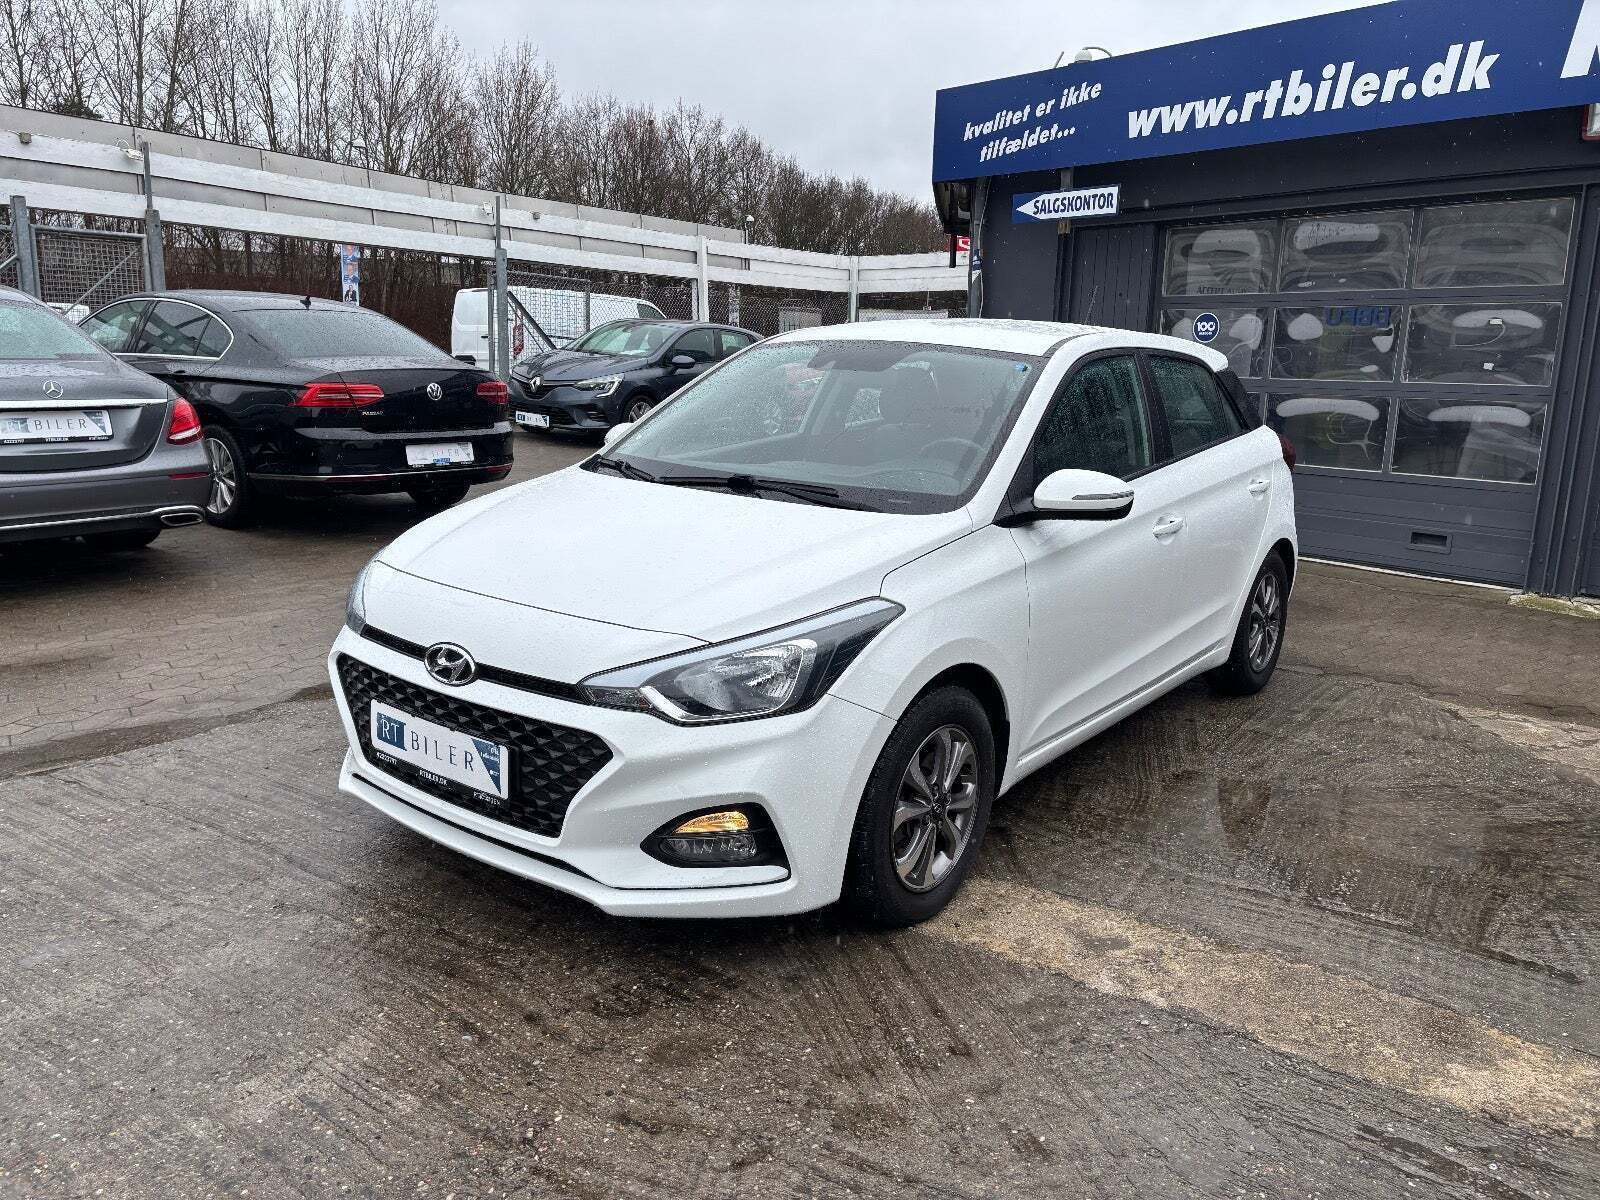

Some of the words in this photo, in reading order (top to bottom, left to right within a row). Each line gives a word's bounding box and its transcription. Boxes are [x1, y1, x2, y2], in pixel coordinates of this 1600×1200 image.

[963, 104, 1031, 141] kvalitet
[1035, 98, 1055, 118] er
[1059, 81, 1102, 110] ikke
[1128, 39, 1500, 139] www.rtbiler.dk
[1032, 192, 1114, 215] SALGSKONTOR
[34, 418, 87, 431] BILER
[381, 718, 400, 743] RT
[410, 730, 474, 772] BILER
